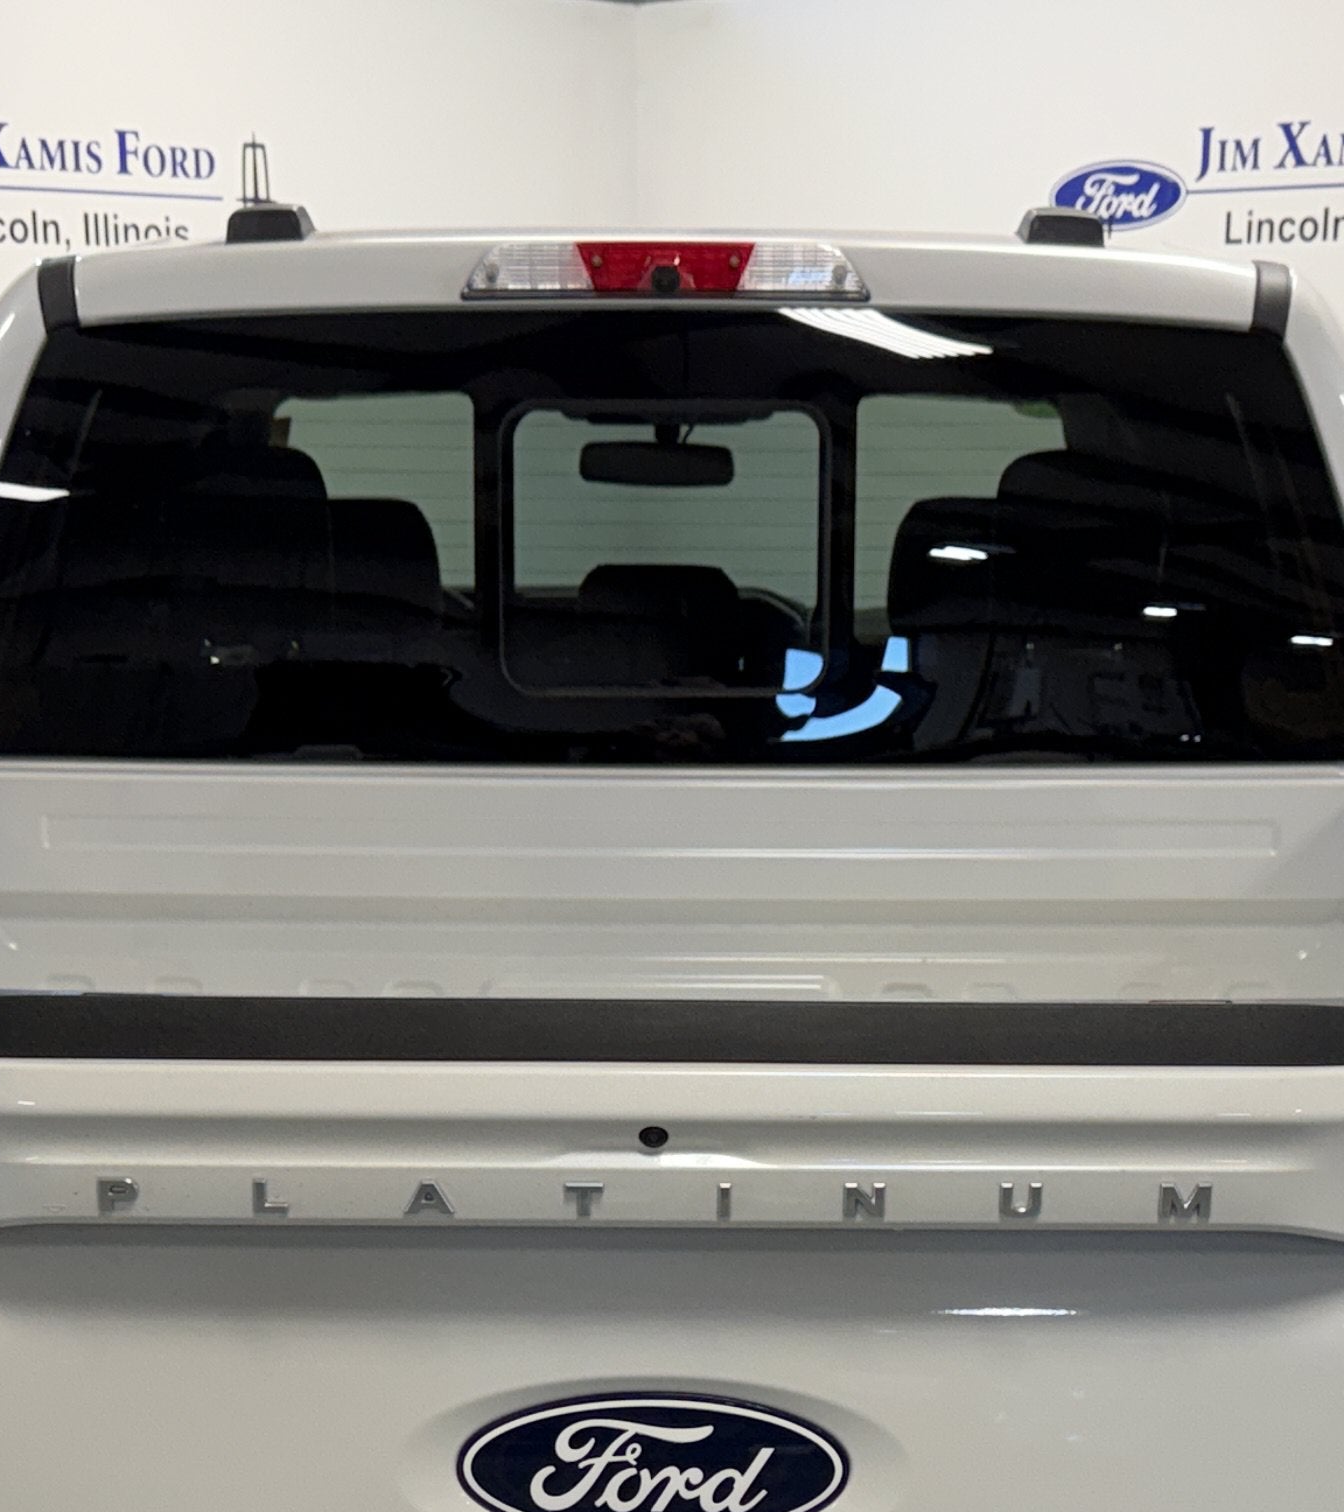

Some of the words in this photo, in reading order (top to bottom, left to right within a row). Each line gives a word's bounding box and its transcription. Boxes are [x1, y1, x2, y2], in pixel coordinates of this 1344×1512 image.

[114, 129, 216, 180] FORD
[1195, 126, 1262, 182] JIM
[1074, 171, 1160, 220] Ford
[96, 1178, 1213, 1220] PLATINUM
